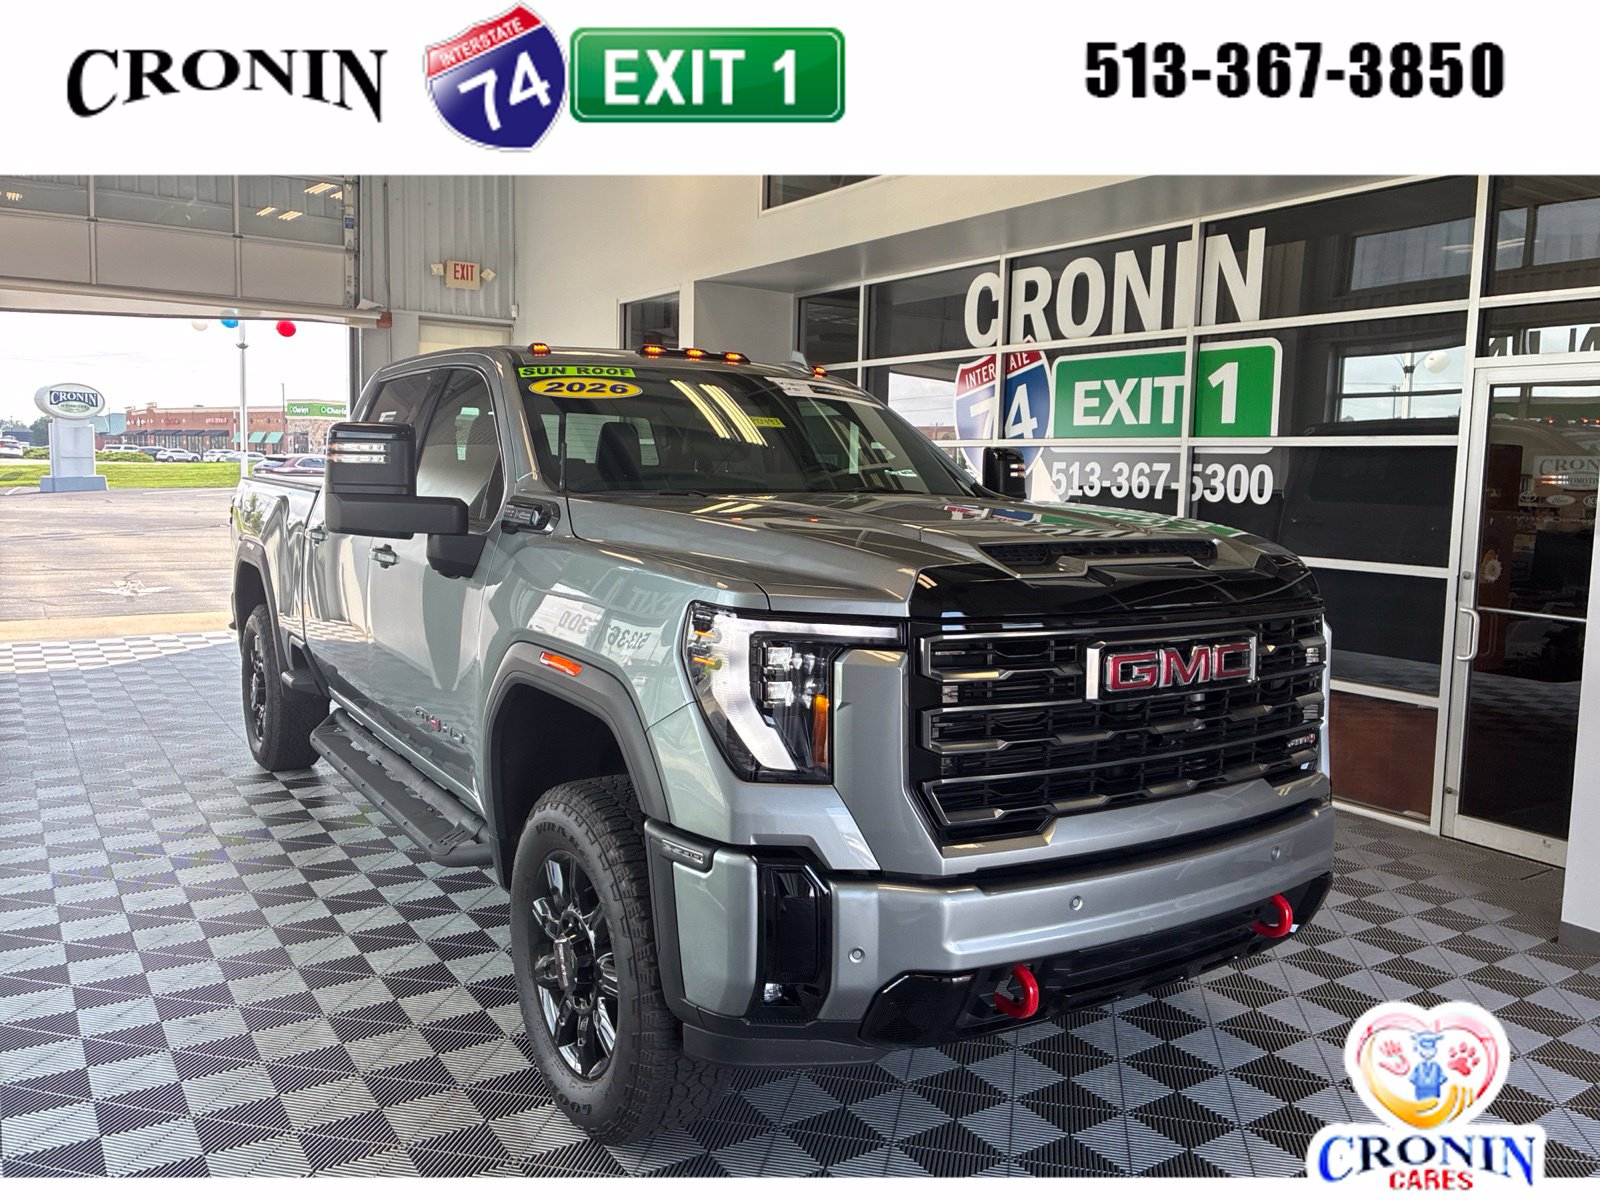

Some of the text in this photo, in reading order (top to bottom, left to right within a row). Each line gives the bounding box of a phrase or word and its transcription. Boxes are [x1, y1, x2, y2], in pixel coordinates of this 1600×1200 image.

[453, 262, 476, 282] EXIT
[965, 227, 1266, 348] CRONIN
[522, 367, 632, 376] SUN ROOF
[543, 381, 629, 394] 2026
[965, 351, 1031, 391] INTERATE
[50, 391, 97, 407] CRONIN
[969, 383, 1039, 440] 74
[1072, 361, 1239, 427] EXIT 1
[1105, 641, 1251, 692] GMC
